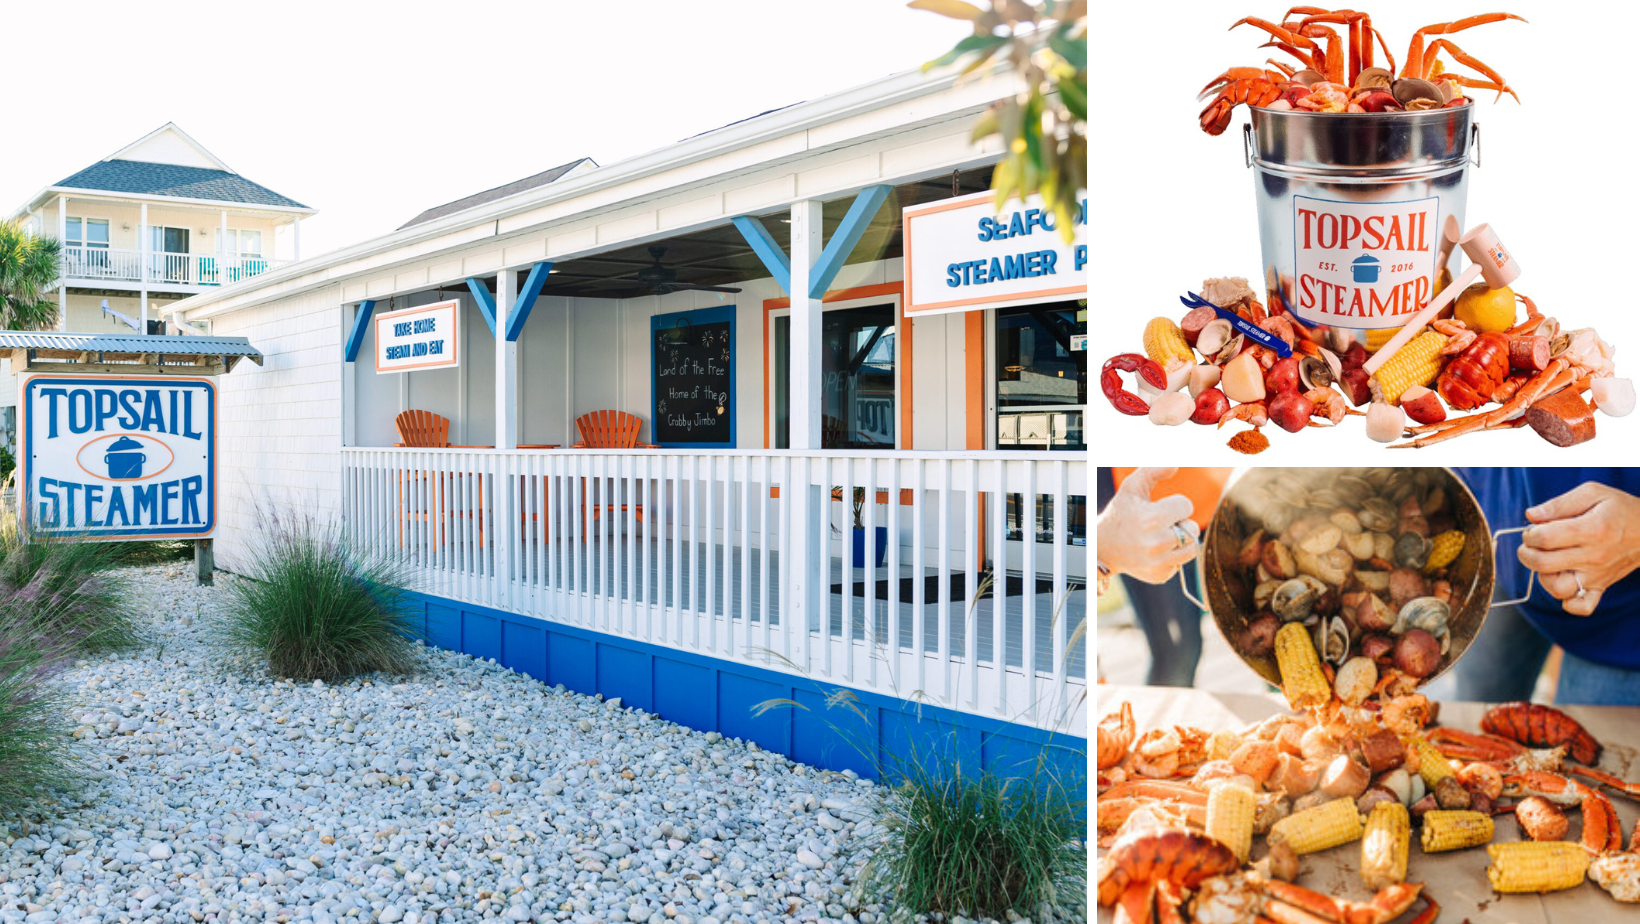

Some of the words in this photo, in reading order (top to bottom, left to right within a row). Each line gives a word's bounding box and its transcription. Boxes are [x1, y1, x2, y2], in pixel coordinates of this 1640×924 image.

[1298, 208, 1429, 252] TOPSAIL
[946, 249, 1058, 288] STEAMER
[1318, 261, 1338, 272] EST.
[1391, 262, 1414, 273] 2016
[1299, 273, 1429, 318] STEAMER
[393, 321, 412, 337] TAKE
[413, 317, 436, 335] HOME
[386, 344, 411, 360] STEAM
[412, 342, 428, 357] AND
[429, 339, 444, 355] EAT
[659, 362, 676, 377] Land
[679, 357, 690, 376] of
[692, 360, 705, 375] the
[708, 357, 725, 376] Free
[669, 387, 689, 399] Home
[691, 385, 700, 399] of
[703, 385, 718, 400] the
[39, 388, 203, 441] TOPSAIL
[667, 413, 692, 432] Crabby
[694, 412, 716, 427] Jimbo
[39, 475, 203, 528] STEAMER
